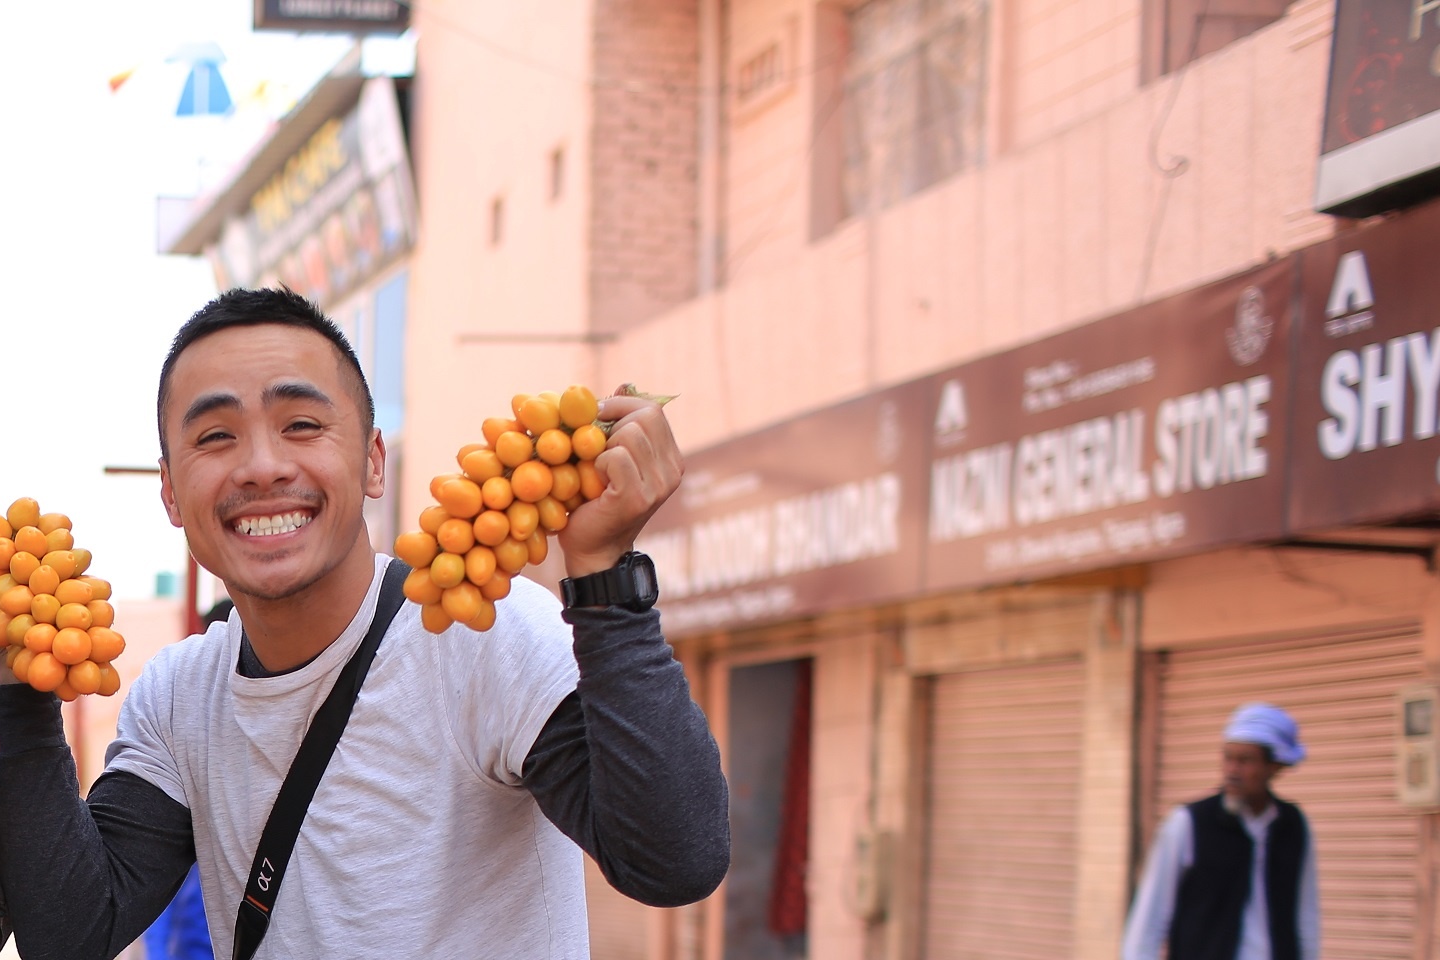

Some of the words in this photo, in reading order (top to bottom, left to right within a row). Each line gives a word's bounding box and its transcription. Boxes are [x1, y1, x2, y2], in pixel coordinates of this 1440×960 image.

[1013, 408, 1151, 527] GENERAL
[1154, 374, 1271, 499] STORE
[1317, 325, 1440, 461] SHY
